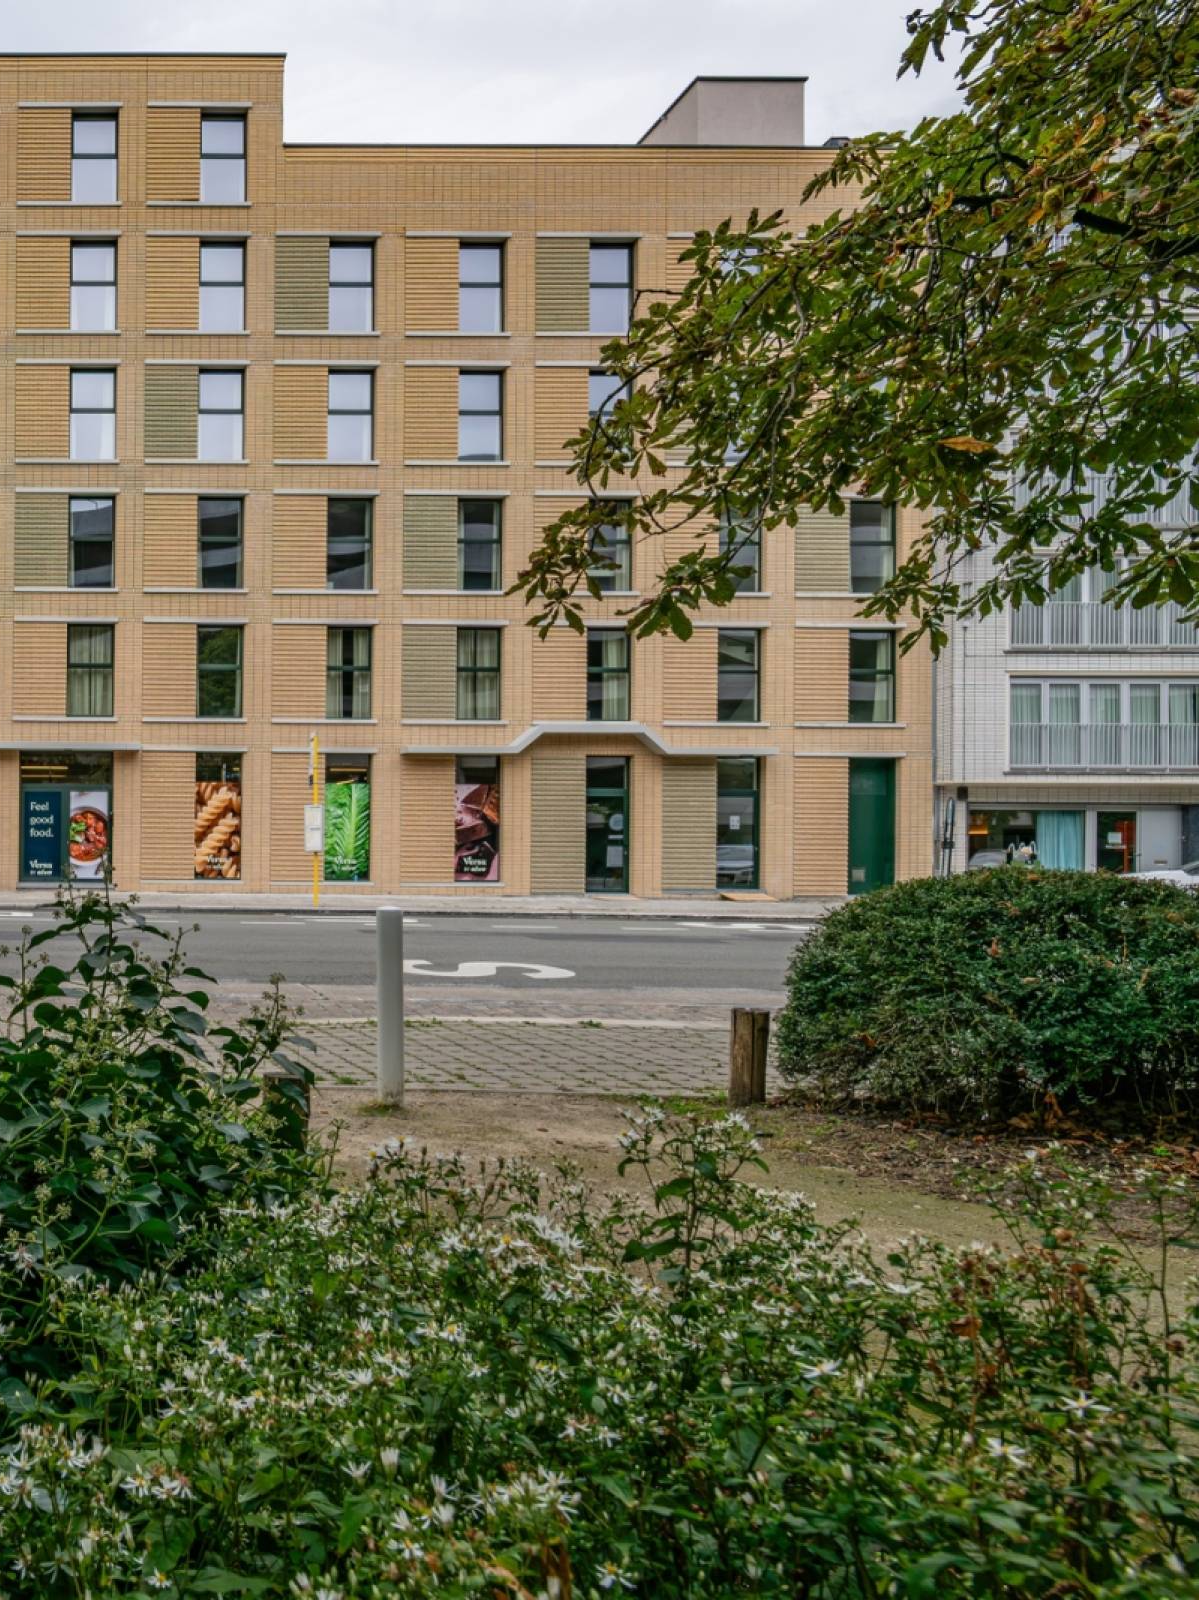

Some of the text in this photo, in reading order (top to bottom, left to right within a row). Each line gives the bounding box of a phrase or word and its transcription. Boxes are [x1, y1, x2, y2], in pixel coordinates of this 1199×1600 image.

[30, 801, 50, 811] Feel
[30, 814, 55, 826] good
[30, 827, 55, 838] food.
